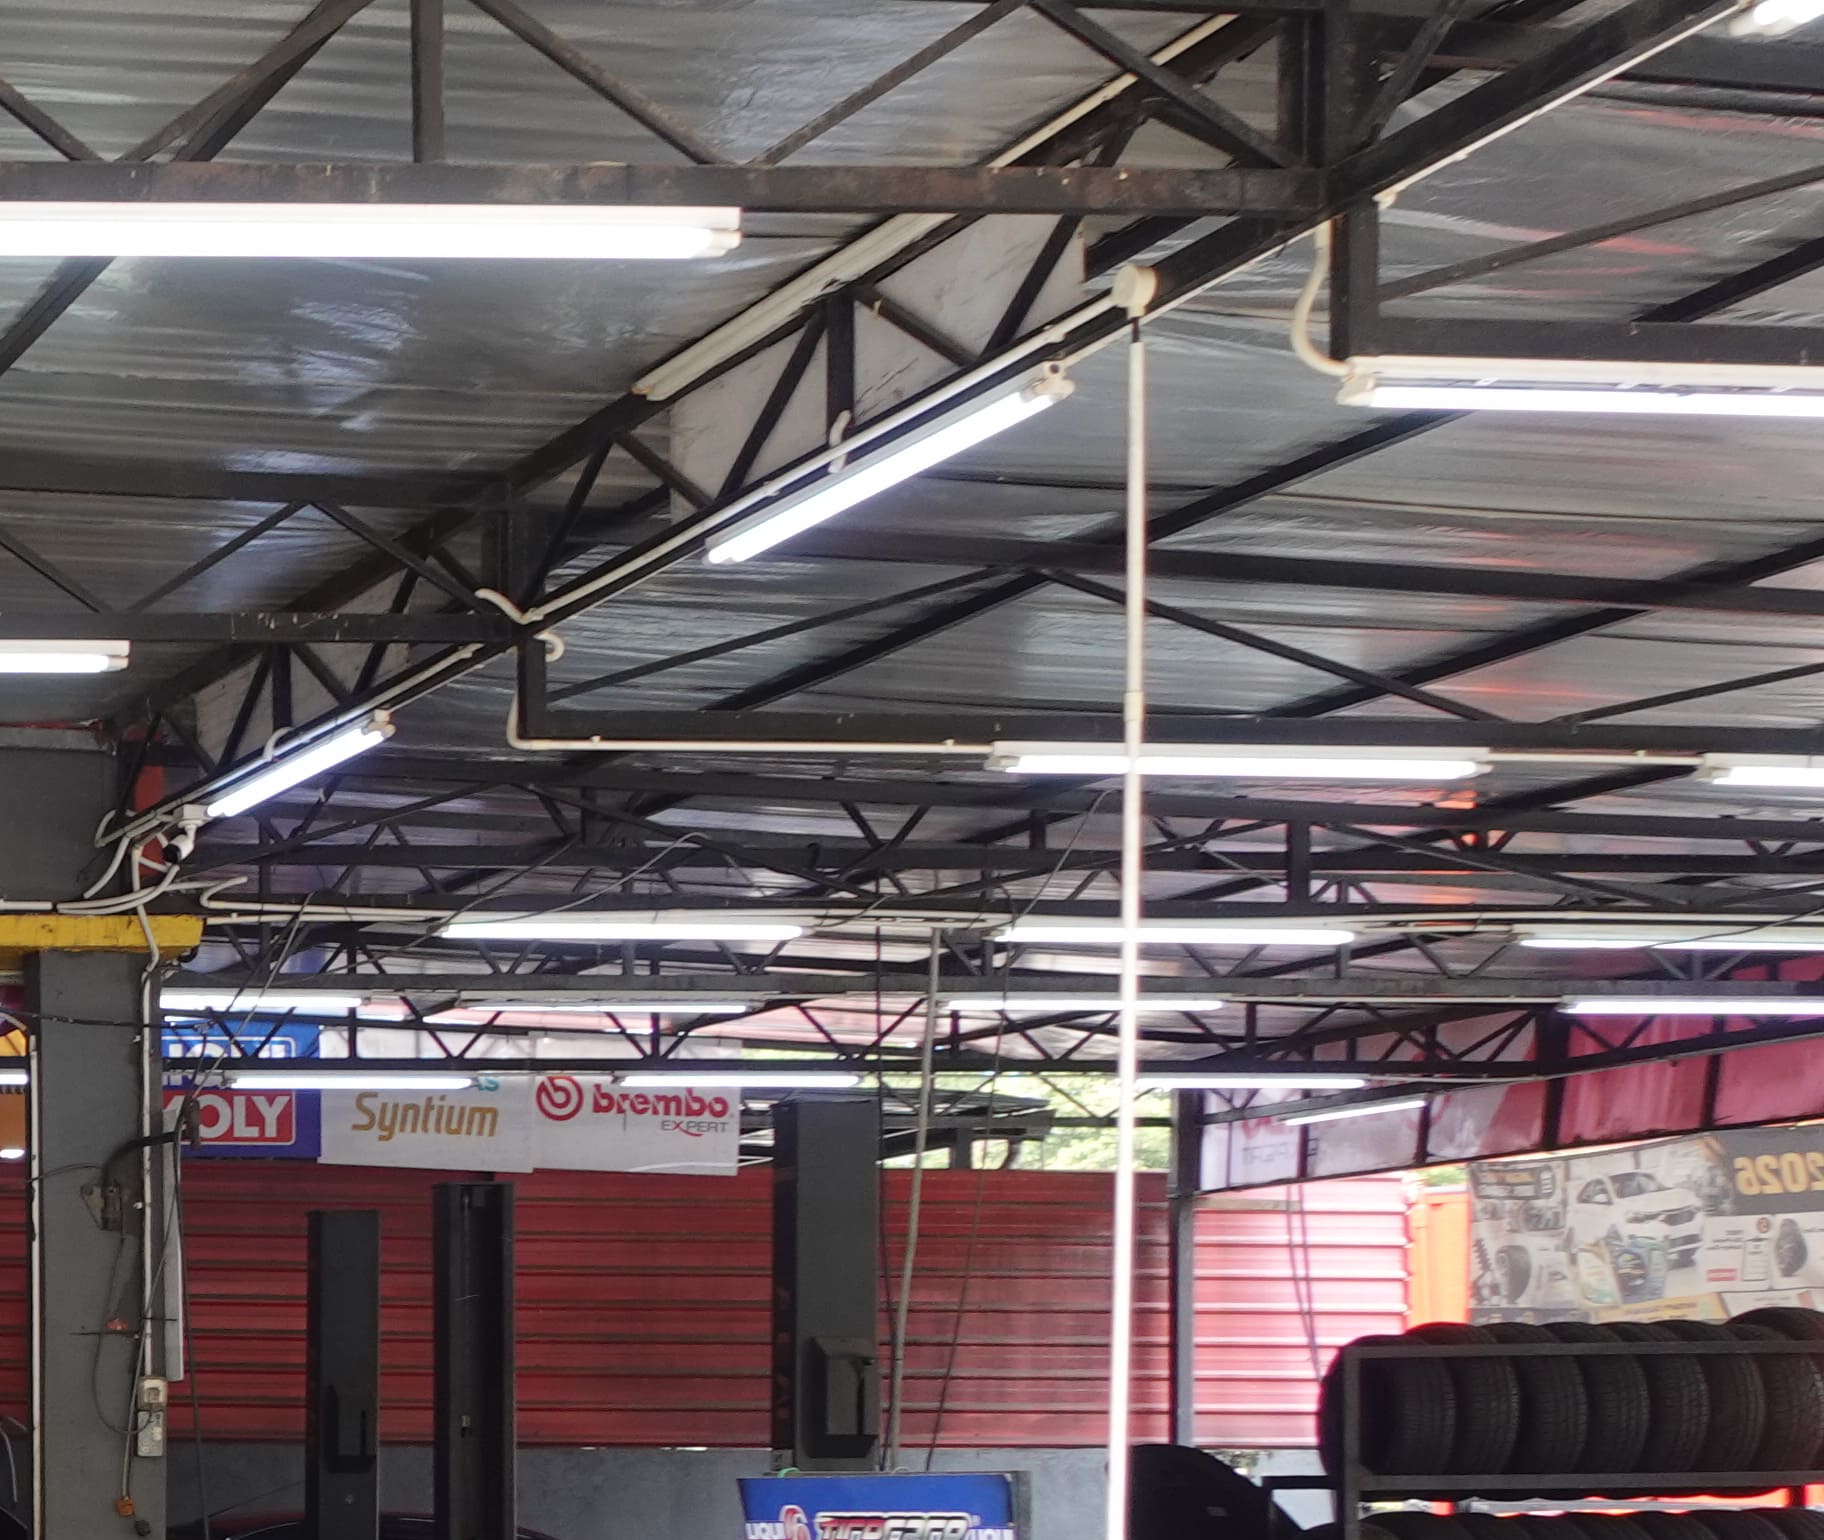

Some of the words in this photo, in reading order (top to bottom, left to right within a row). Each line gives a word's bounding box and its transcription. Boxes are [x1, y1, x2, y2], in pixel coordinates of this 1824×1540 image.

[592, 1084, 730, 1119] brembo
[351, 1091, 500, 1141] Syntium
[660, 1118, 730, 1137] EXPERT
[745, 1522, 786, 1540] LIQUI
